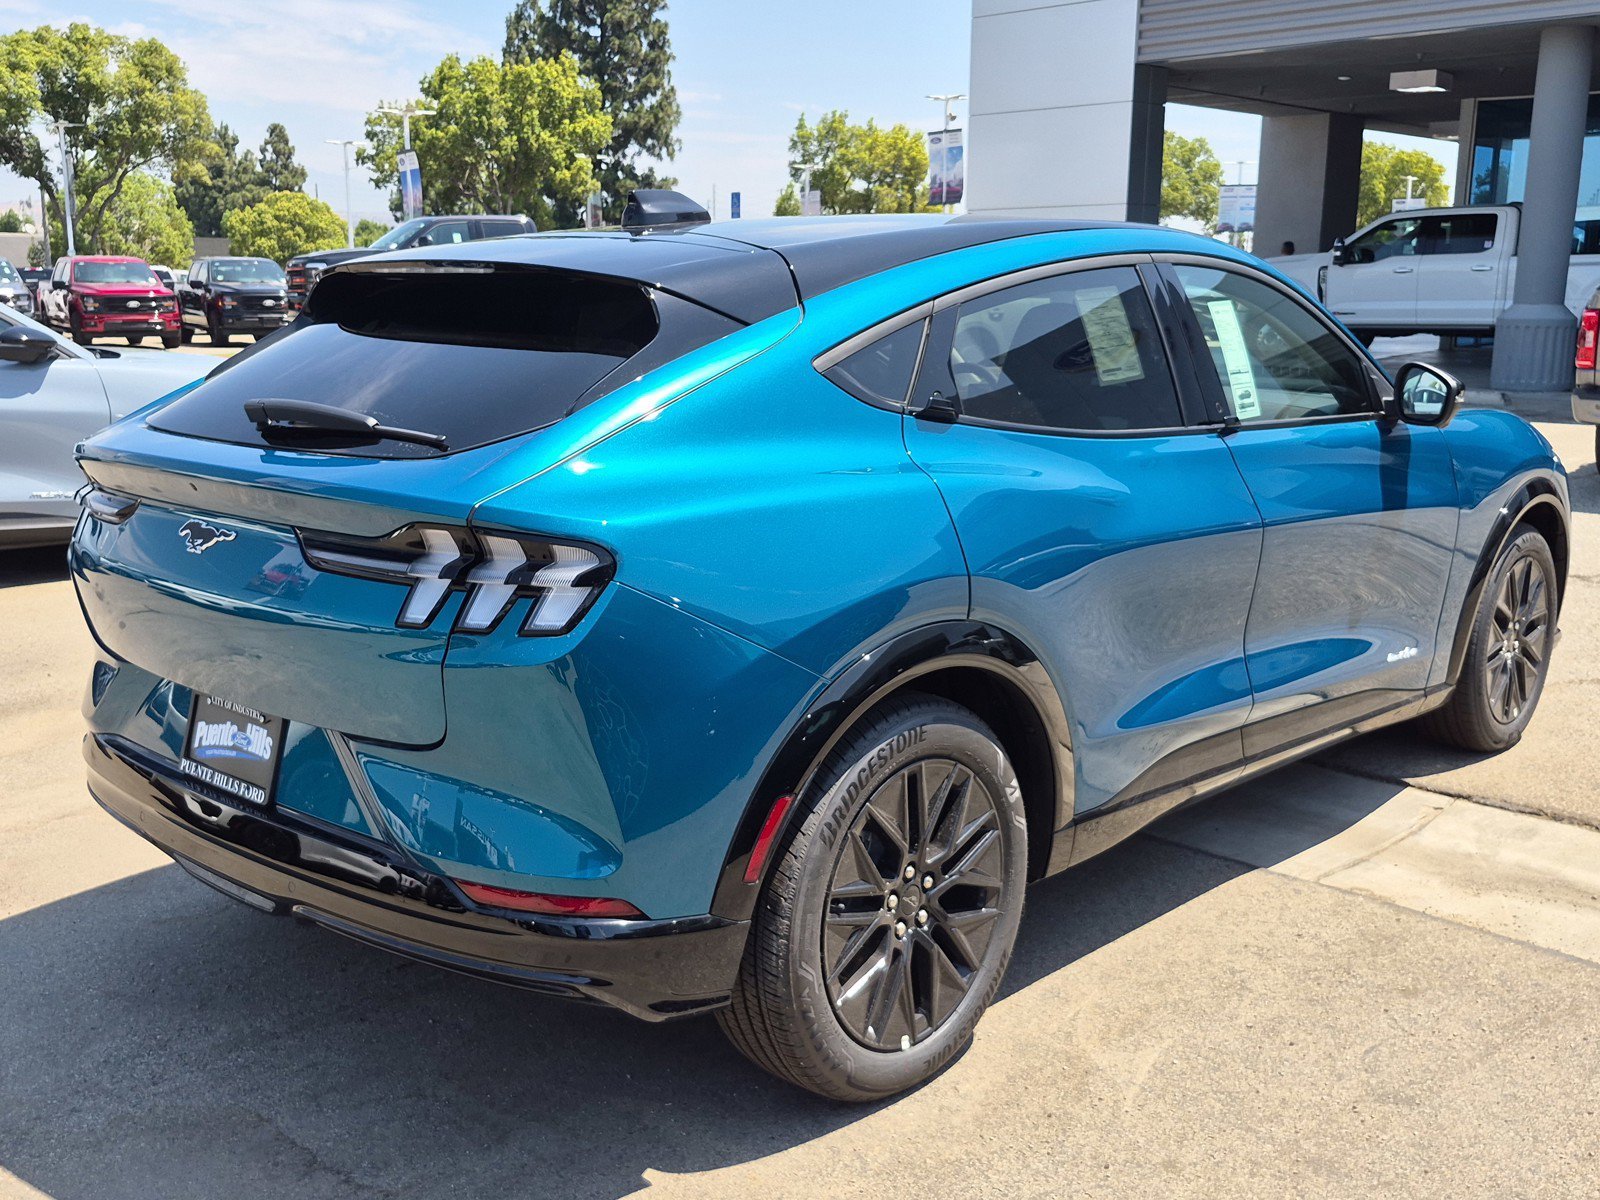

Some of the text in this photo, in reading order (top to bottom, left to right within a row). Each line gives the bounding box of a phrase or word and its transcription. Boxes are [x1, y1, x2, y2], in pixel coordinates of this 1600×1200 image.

[211, 695, 261, 721] CITY OF INDUSTRY
[193, 720, 273, 760] Puente Hills
[180, 758, 266, 803] PUENTE HILLS FORD
[819, 725, 929, 850] BRIDGESTONE
